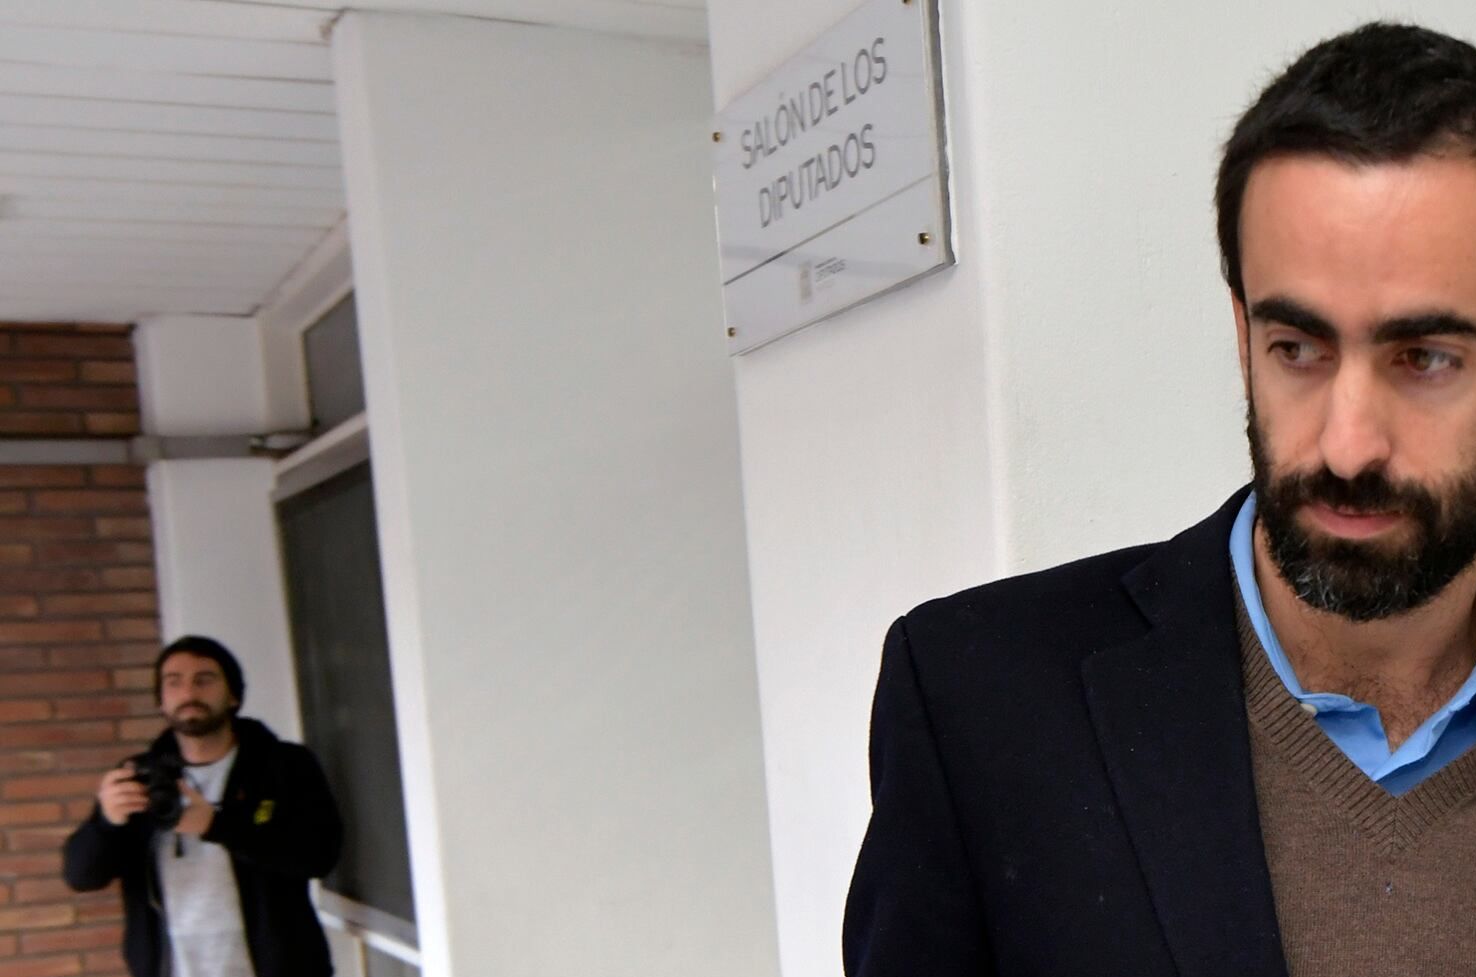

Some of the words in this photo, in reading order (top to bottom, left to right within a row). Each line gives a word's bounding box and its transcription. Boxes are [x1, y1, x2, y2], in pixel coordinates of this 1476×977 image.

[741, 92, 806, 169] SALÓN
[809, 69, 838, 126] DE
[842, 37, 887, 105] LOS
[758, 123, 876, 229] DIPUTADOS
